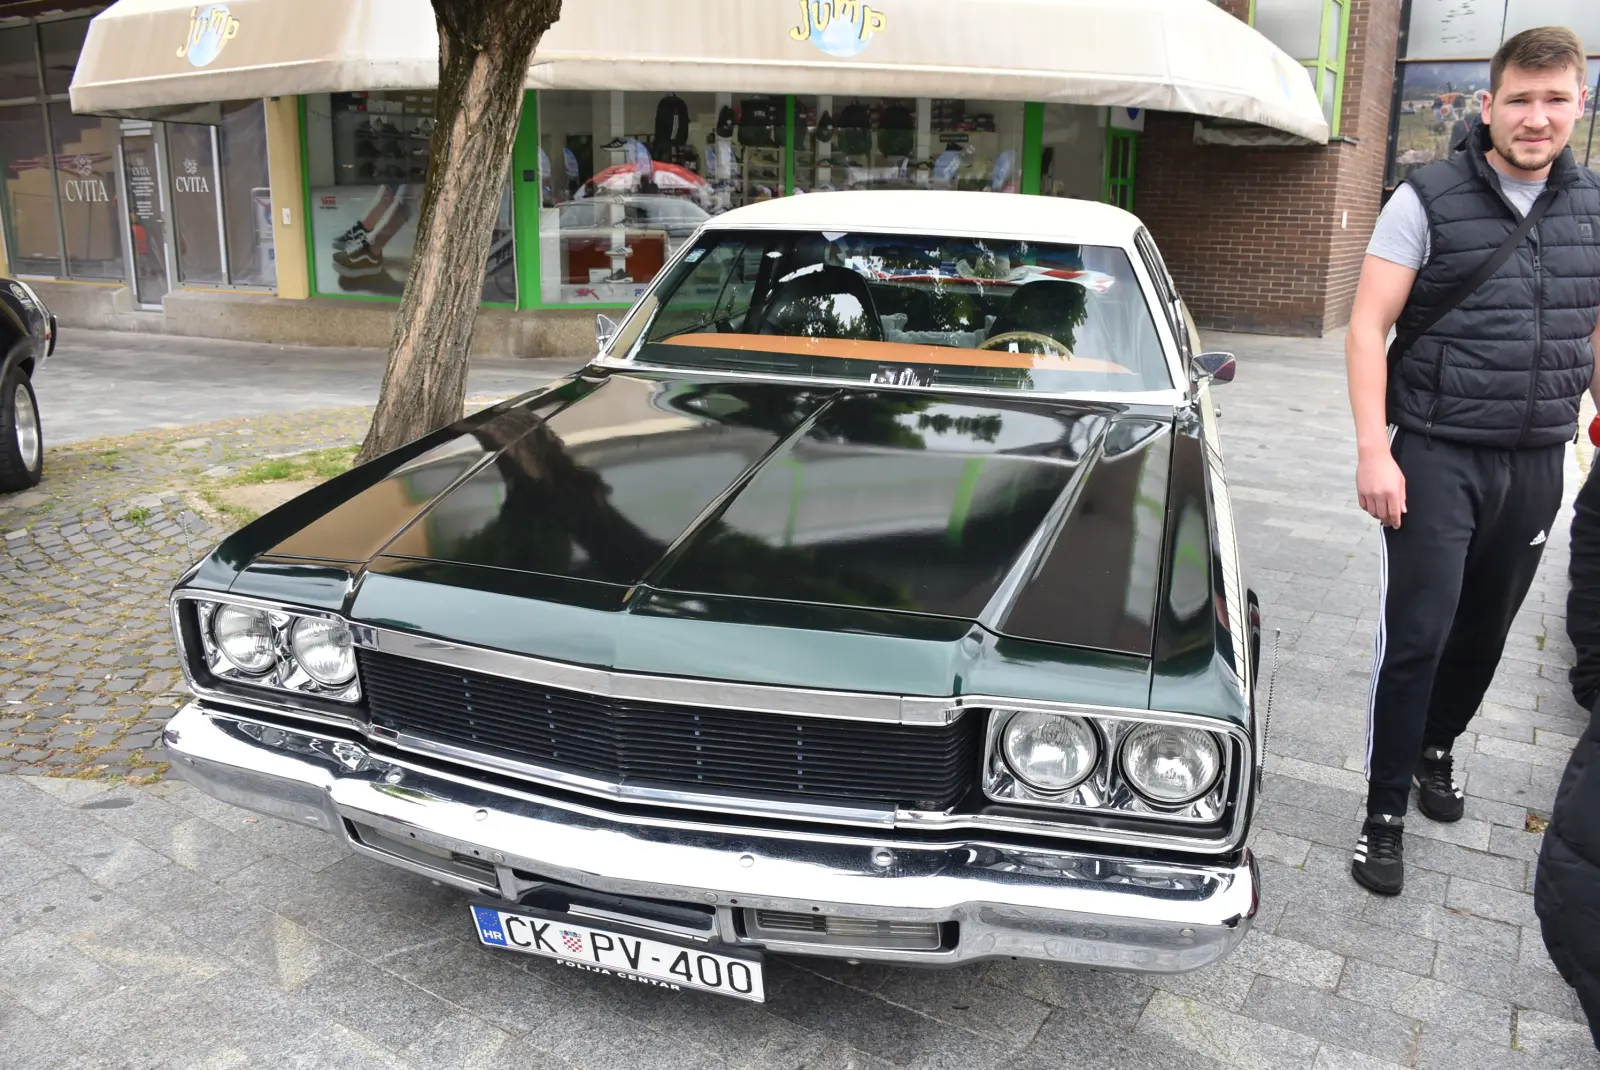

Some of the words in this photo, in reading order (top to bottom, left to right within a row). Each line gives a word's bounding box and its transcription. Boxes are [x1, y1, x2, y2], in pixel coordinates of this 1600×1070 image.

[65, 179, 110, 202] CVITA
[175, 176, 210, 193] CVITA
[482, 928, 504, 941] HR
[504, 915, 558, 954] ČK
[589, 931, 754, 994] PV-400
[556, 958, 612, 976] FOLIJA
[616, 971, 681, 991] CENTAR
